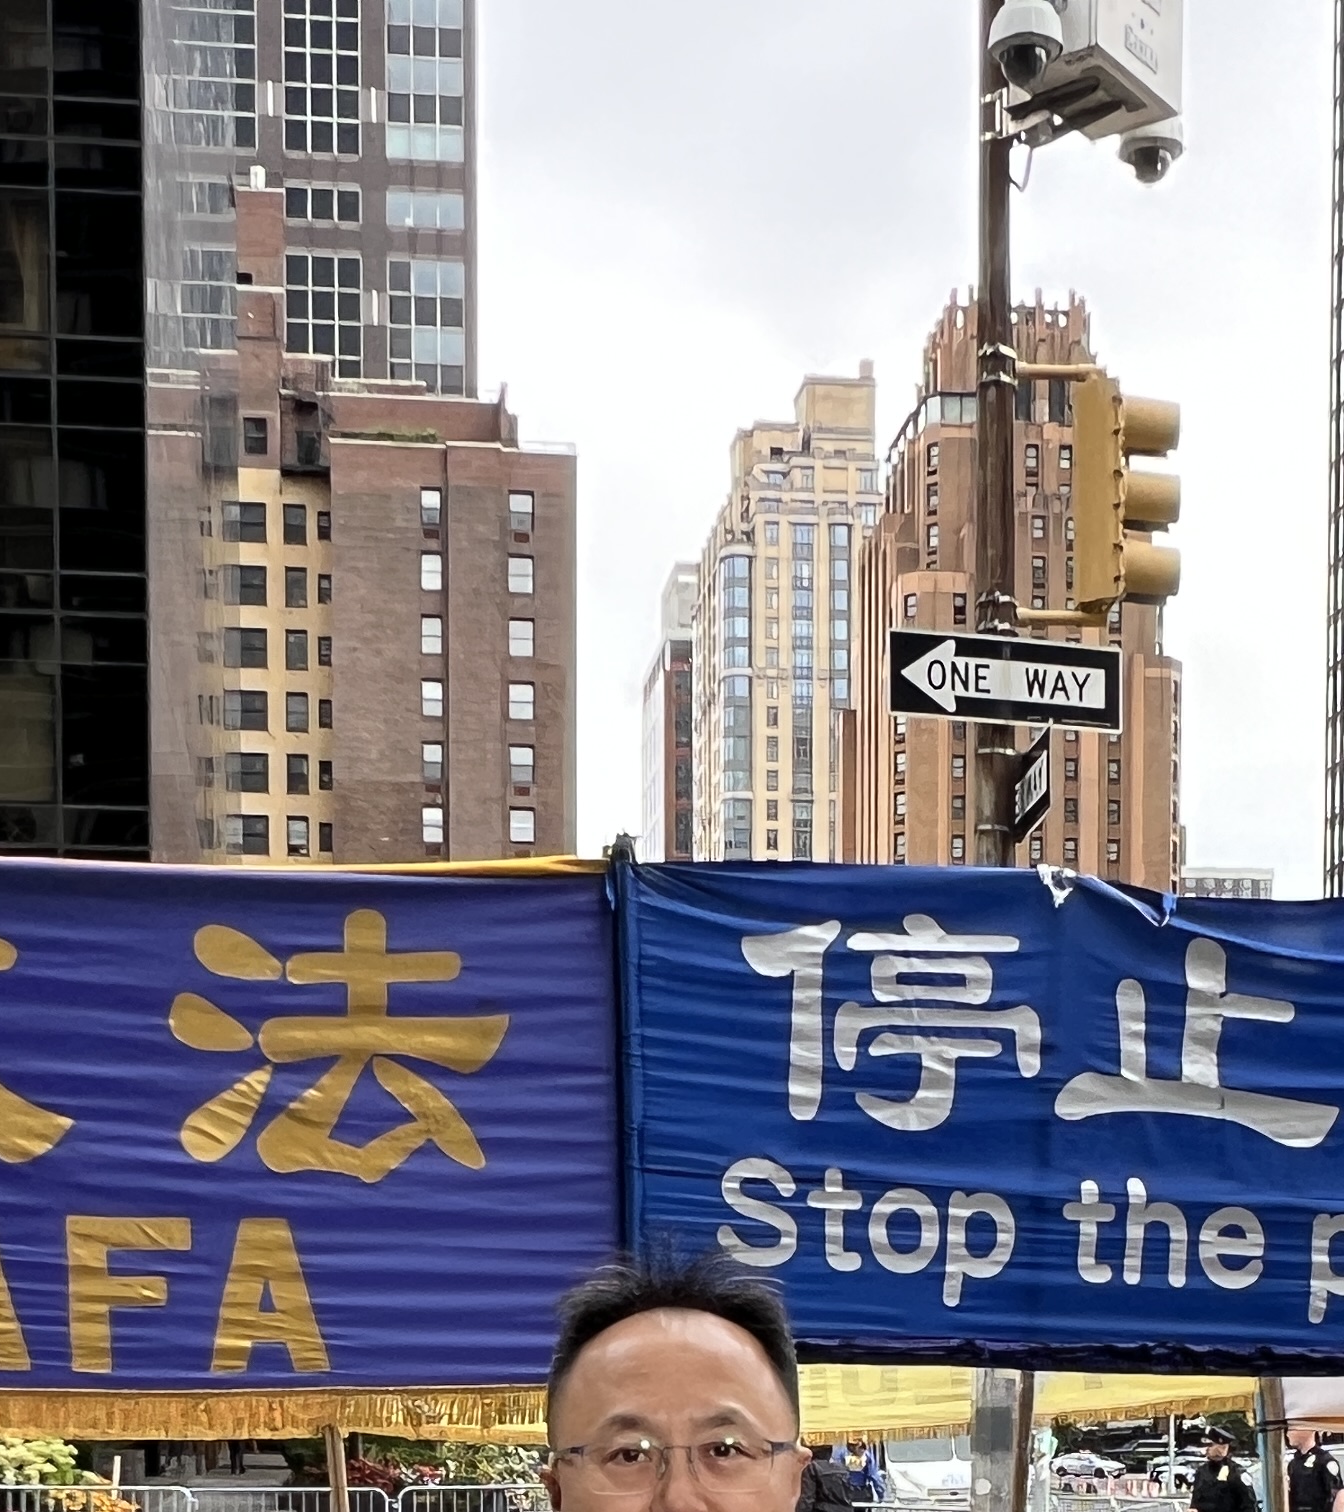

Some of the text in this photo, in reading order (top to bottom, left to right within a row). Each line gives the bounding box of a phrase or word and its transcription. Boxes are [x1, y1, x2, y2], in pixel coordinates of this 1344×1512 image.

[927, 660, 1091, 702] ONE WAY
[716, 1157, 1016, 1308] Stop
[1062, 1178, 1265, 1289] the
